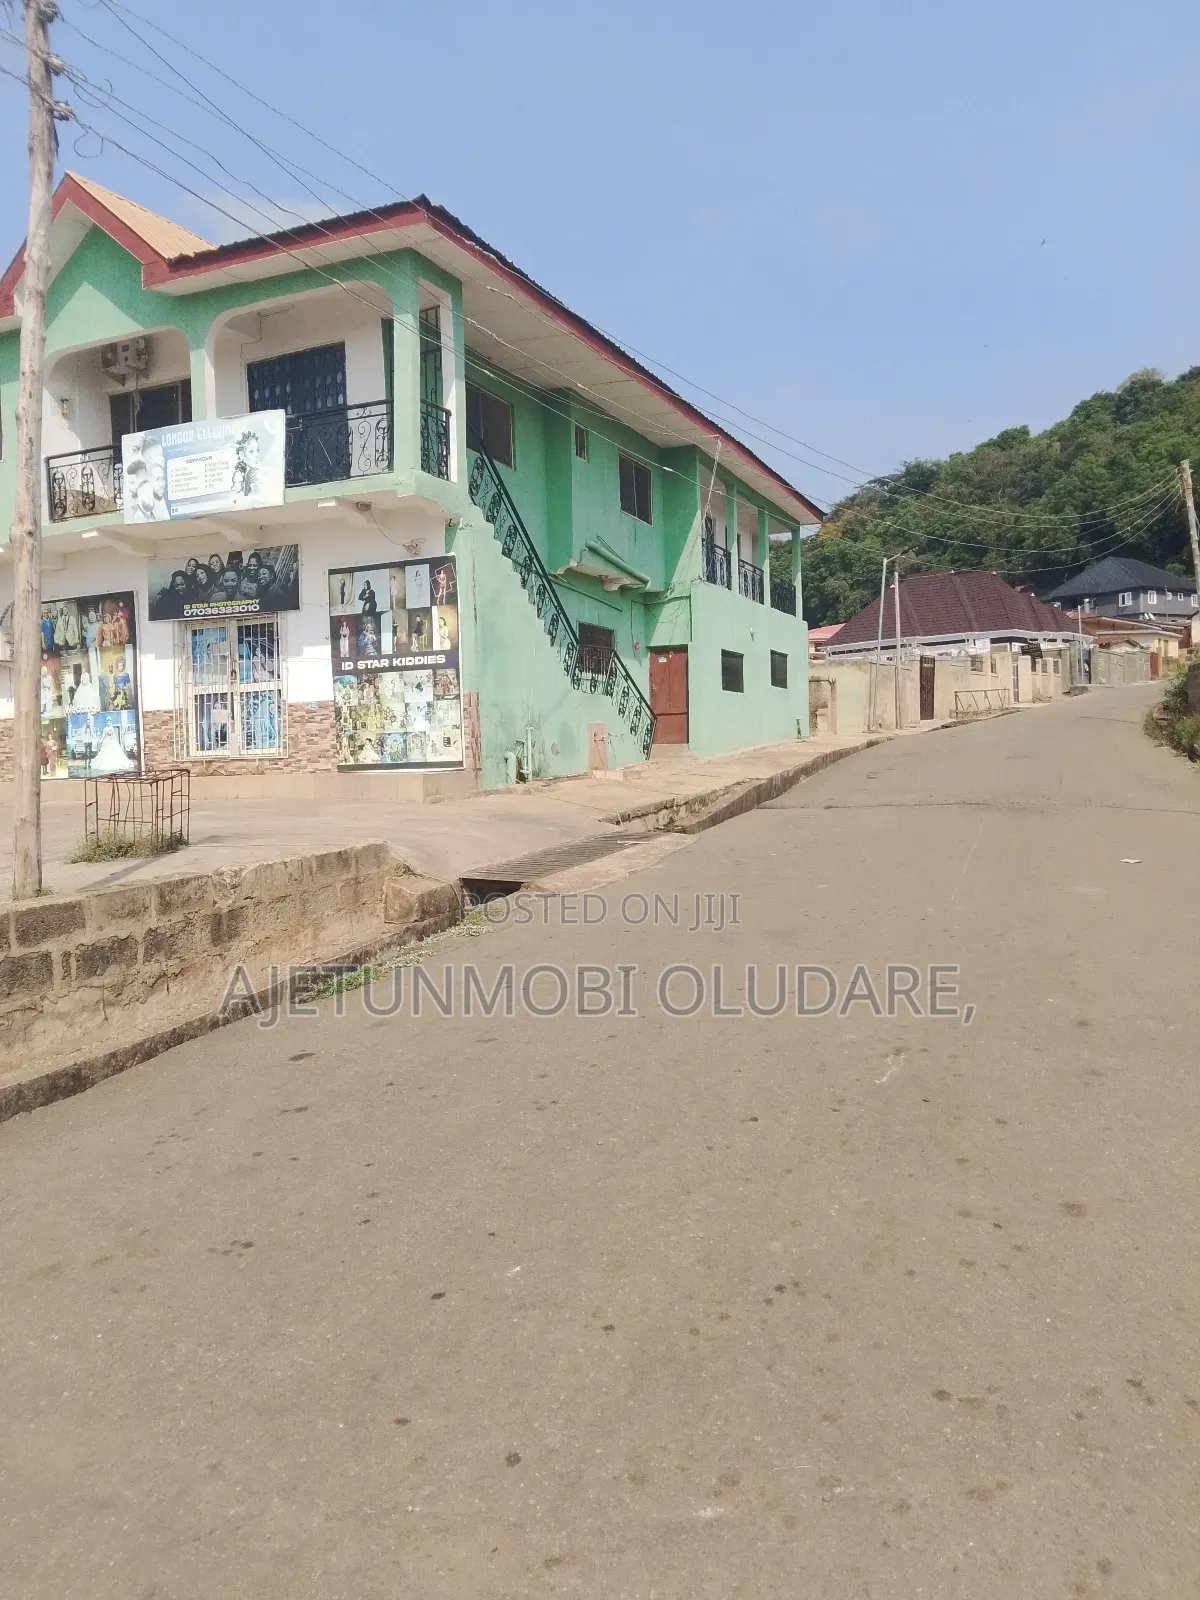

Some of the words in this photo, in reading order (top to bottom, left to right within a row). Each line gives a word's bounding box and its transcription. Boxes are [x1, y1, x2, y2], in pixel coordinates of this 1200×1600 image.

[161, 429, 194, 447] LONDON
[183, 604, 260, 617] 07036323010
[209, 599, 260, 608] PHOTOGRAPHY
[341, 661, 354, 671] ID
[357, 658, 390, 670] STAR
[392, 654, 446, 667] KIDDIES
